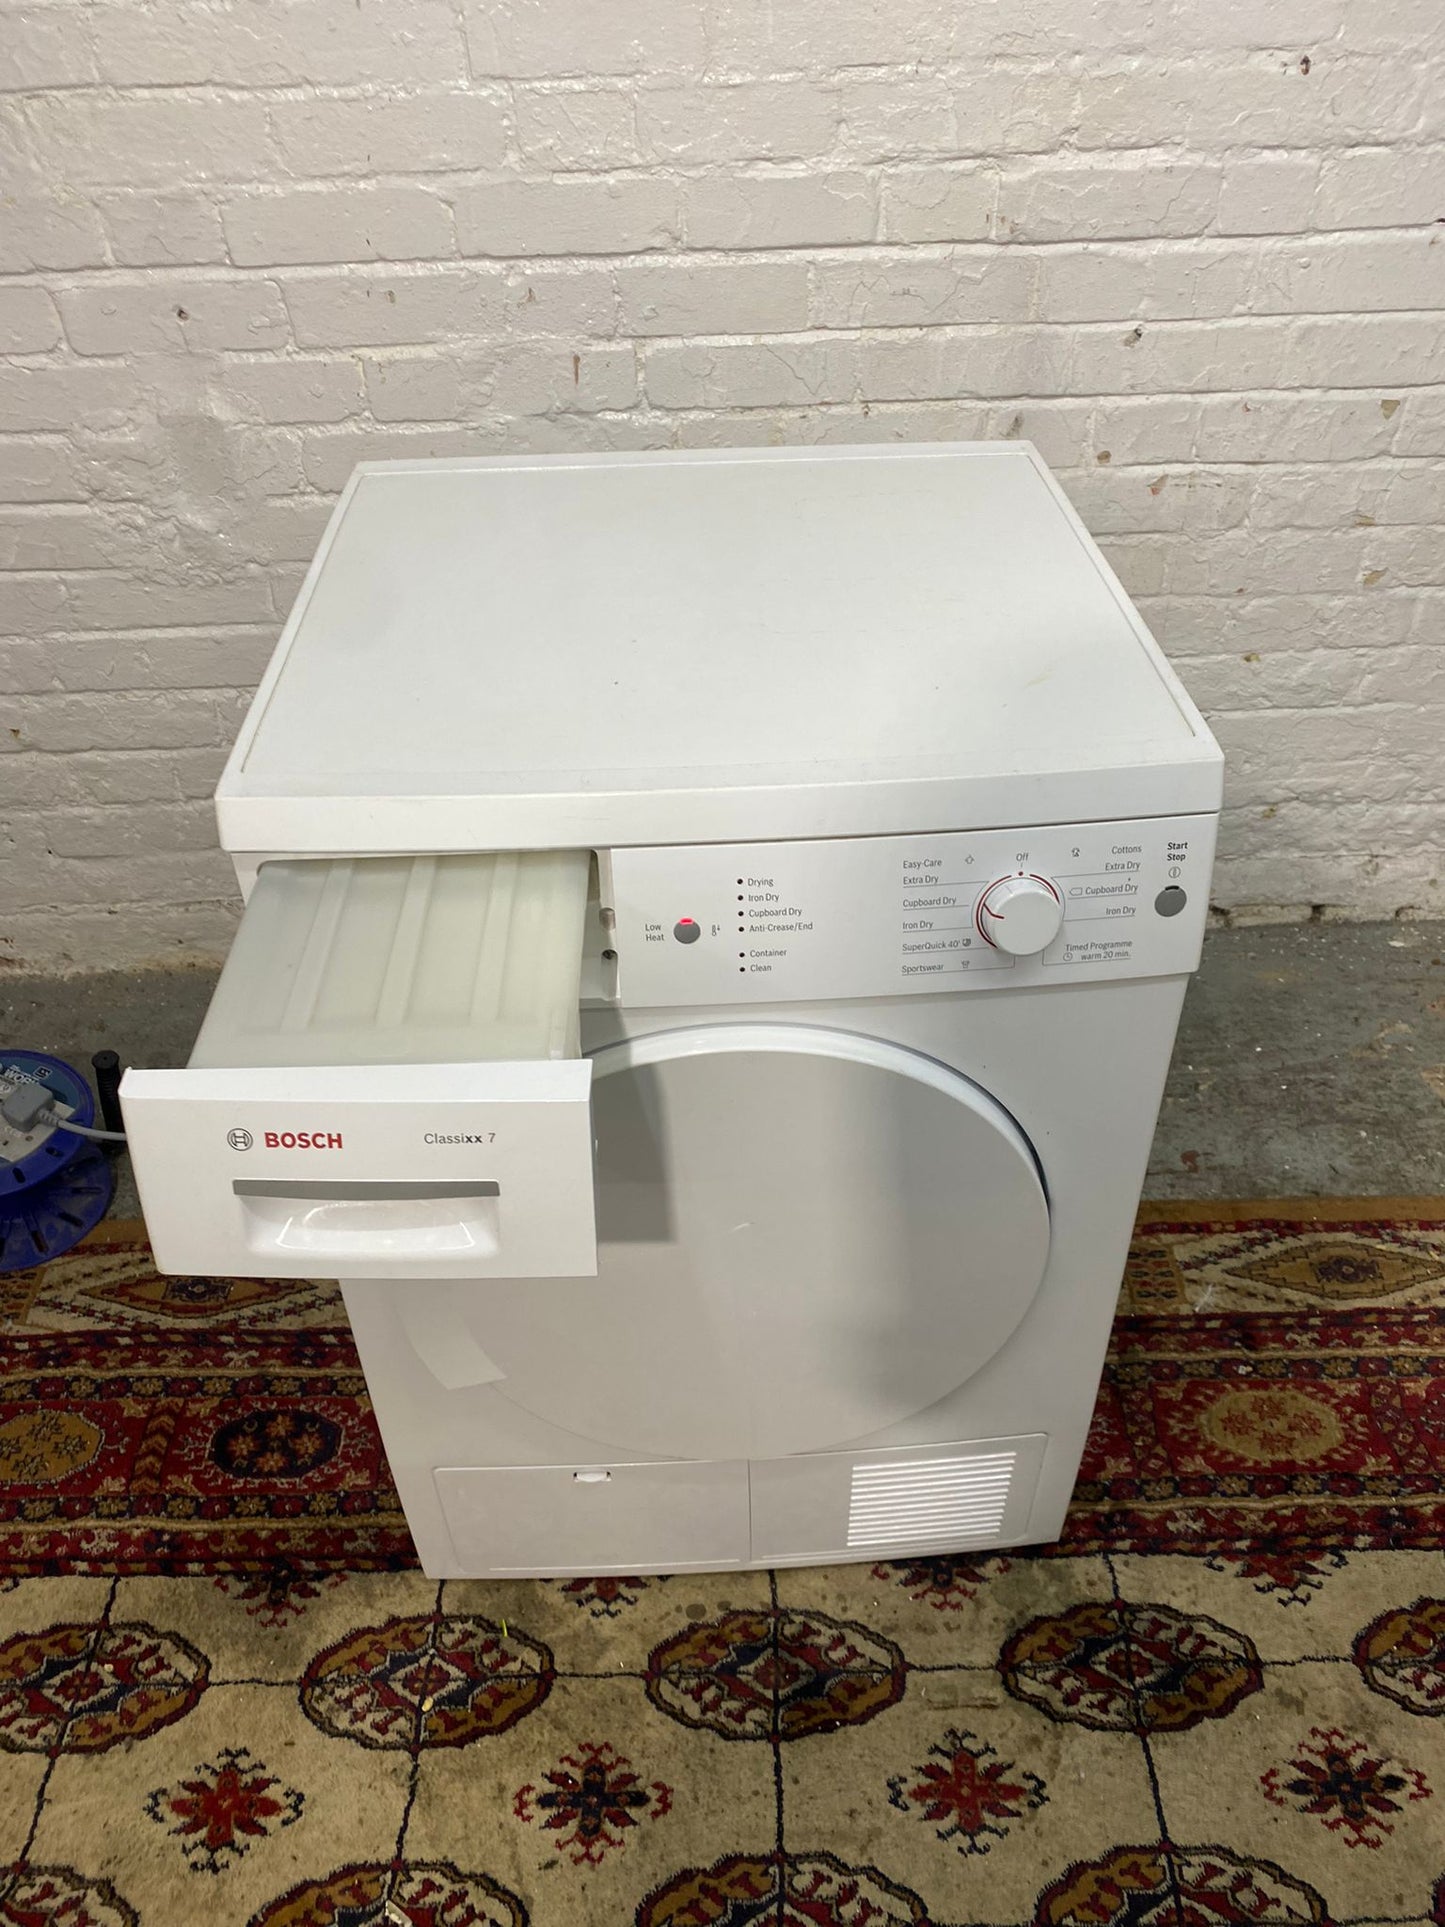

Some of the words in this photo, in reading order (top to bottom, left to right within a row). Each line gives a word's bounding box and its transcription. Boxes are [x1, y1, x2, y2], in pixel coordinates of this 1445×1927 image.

[1111, 845, 1142, 855] Cottons
[1167, 841, 1188, 851] Start
[1016, 852, 1029, 862] Off
[1167, 853, 1186, 862] Stop
[903, 858, 942, 870] Easy-Care
[1105, 862, 1125, 871] Extra
[1126, 860, 1141, 871] Dry
[747, 878, 774, 887] Drying
[903, 876, 923, 885] Extra
[924, 874, 939, 885] Dry
[1085, 884, 1124, 896] Cupboard
[1125, 883, 1139, 894] Dry
[748, 894, 764, 902] Iron
[765, 892, 780, 903] Dry
[903, 897, 942, 908] Cupboard
[942, 896, 957, 906] Dry
[749, 909, 788, 919] Cupboard
[788, 907, 802, 918] Dry
[1105, 907, 1121, 915] Iron
[1122, 906, 1136, 916] Dry
[645, 923, 662, 932] Low
[749, 922, 814, 933] Anti-Crease/End
[902, 921, 918, 930] Iron
[919, 920, 934, 930] Dry
[646, 933, 665, 942] Heat
[902, 939, 947, 952] SuperQuick
[1066, 942, 1089, 952] Timed
[1090, 940, 1133, 951] Programme
[750, 949, 787, 958] Container
[1080, 953, 1102, 961] warm
[1103, 951, 1113, 959] 20
[750, 964, 772, 972] Clean
[902, 963, 944, 974] Sportswear
[263, 1132, 343, 1149] BOSCH
[423, 1132, 483, 1145] Classixx
[488, 1132, 497, 1144] 7
